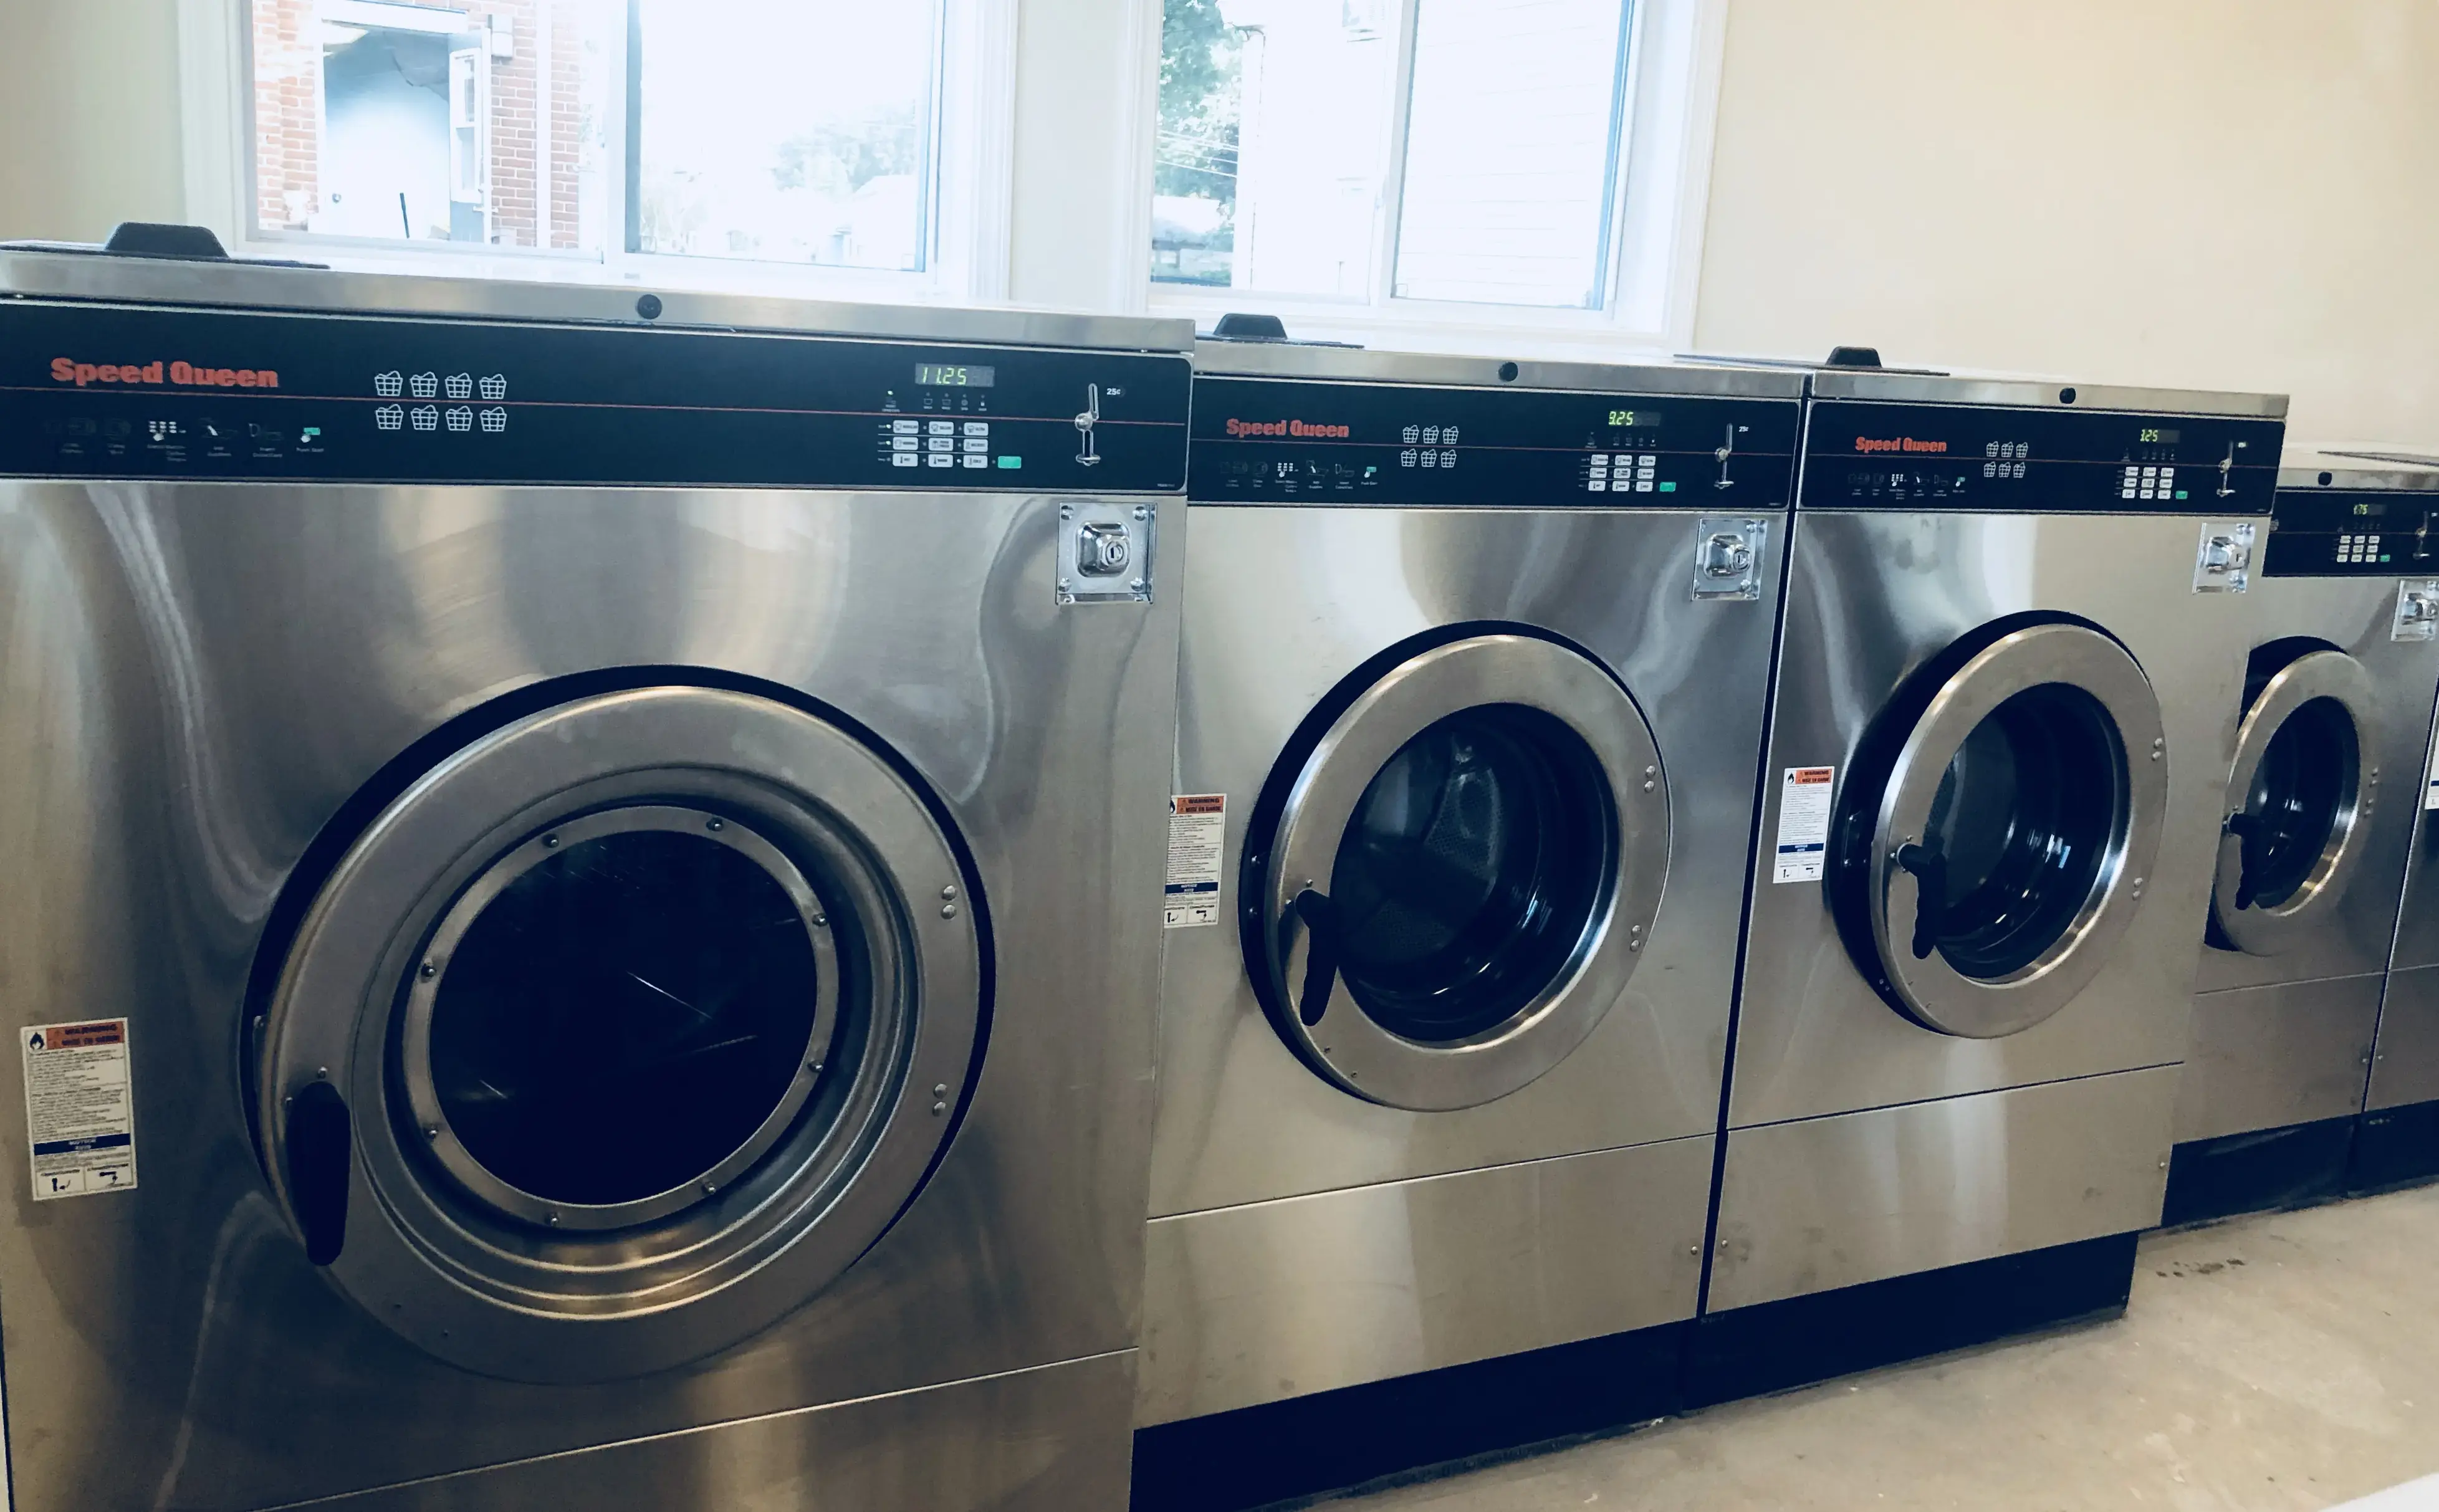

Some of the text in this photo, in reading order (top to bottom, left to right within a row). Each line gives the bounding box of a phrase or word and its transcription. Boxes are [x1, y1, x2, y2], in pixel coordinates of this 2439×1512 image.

[51, 358, 279, 388] Speed Queen
[1227, 418, 1349, 438] Speed Queen
[1856, 436, 1947, 453] Speed Queen
